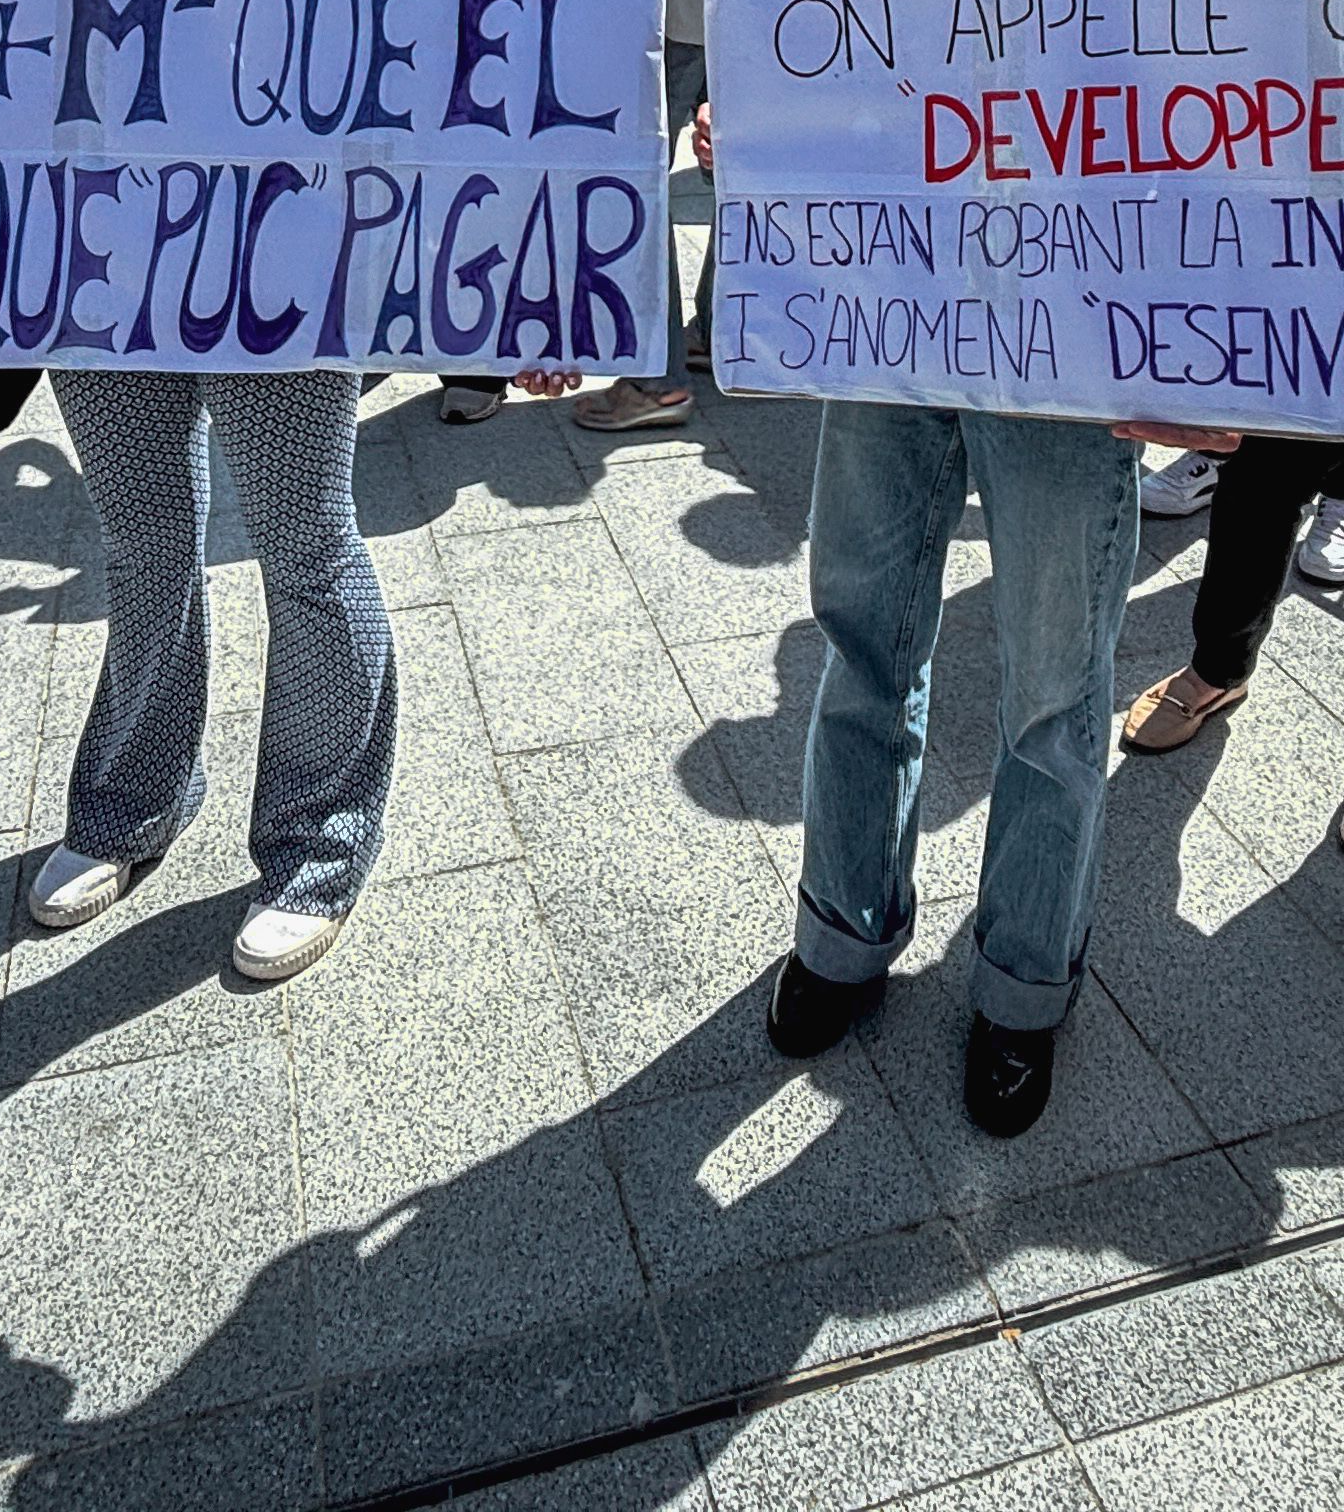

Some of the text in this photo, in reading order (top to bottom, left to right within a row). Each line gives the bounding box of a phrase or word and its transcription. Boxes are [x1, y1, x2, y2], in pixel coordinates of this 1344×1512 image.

[313, 160, 646, 362] PAGAR
[716, 200, 797, 266] ENS
[809, 202, 934, 269] ESTAN
[958, 196, 1152, 278] ROBANT
[1179, 208, 1242, 268] LA
[724, 292, 757, 365] I
[779, 290, 1057, 383] S'ANOMENA
